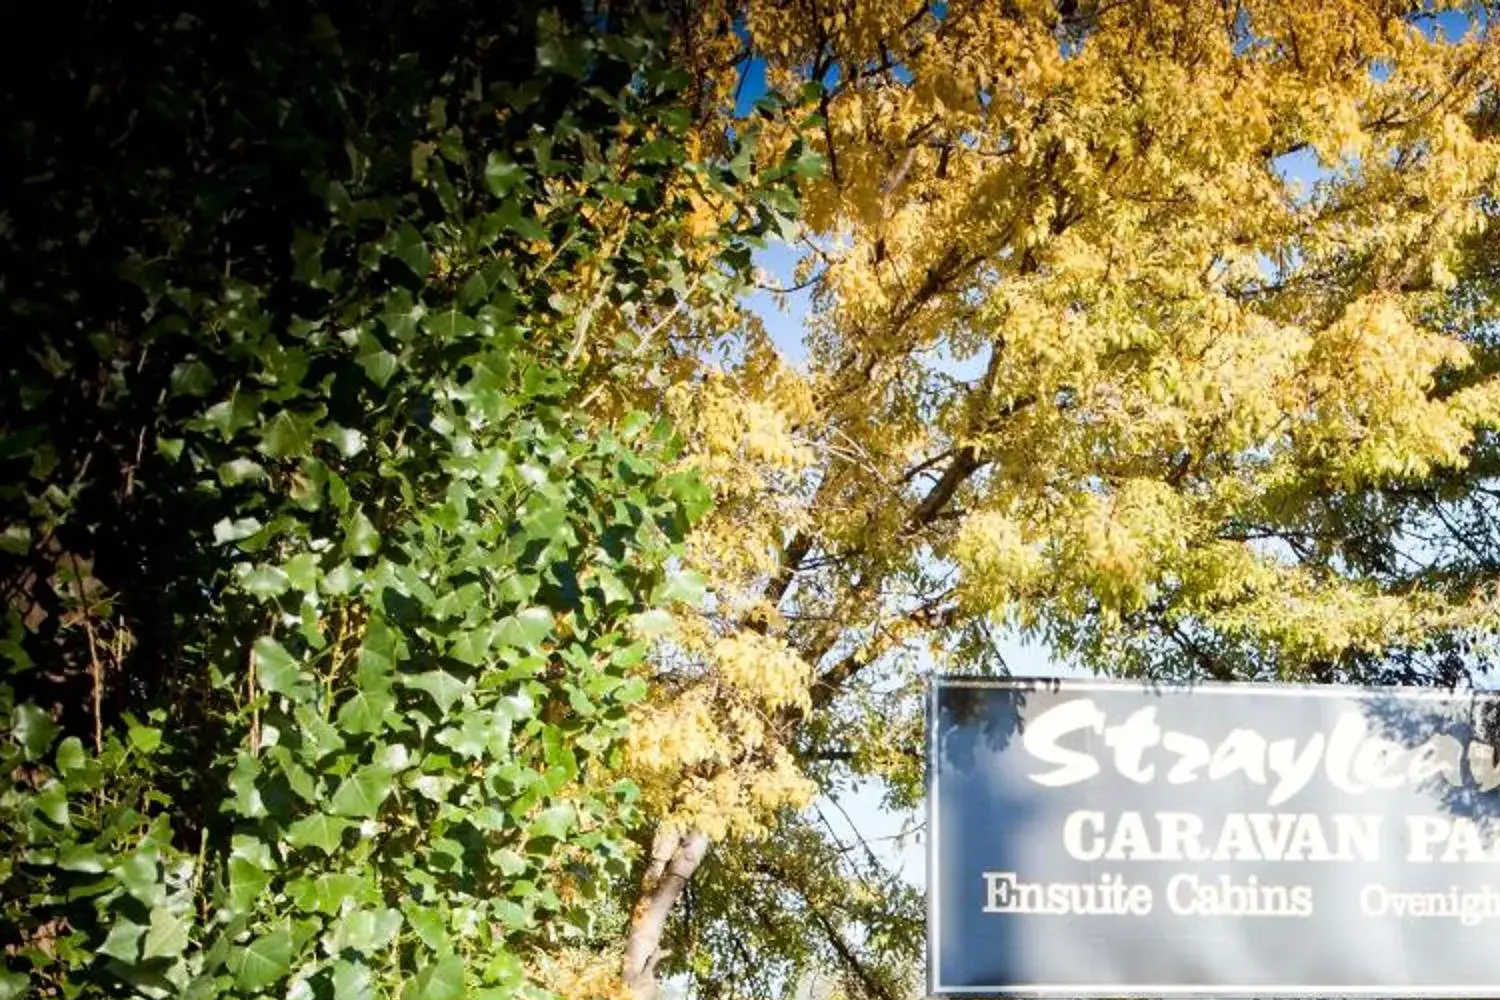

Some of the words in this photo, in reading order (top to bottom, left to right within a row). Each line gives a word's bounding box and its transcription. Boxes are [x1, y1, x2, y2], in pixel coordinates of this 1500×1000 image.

[1062, 810, 1383, 863] CARAVAN
[981, 872, 1153, 916] Ensuite
[1166, 873, 1314, 917] Cabins
